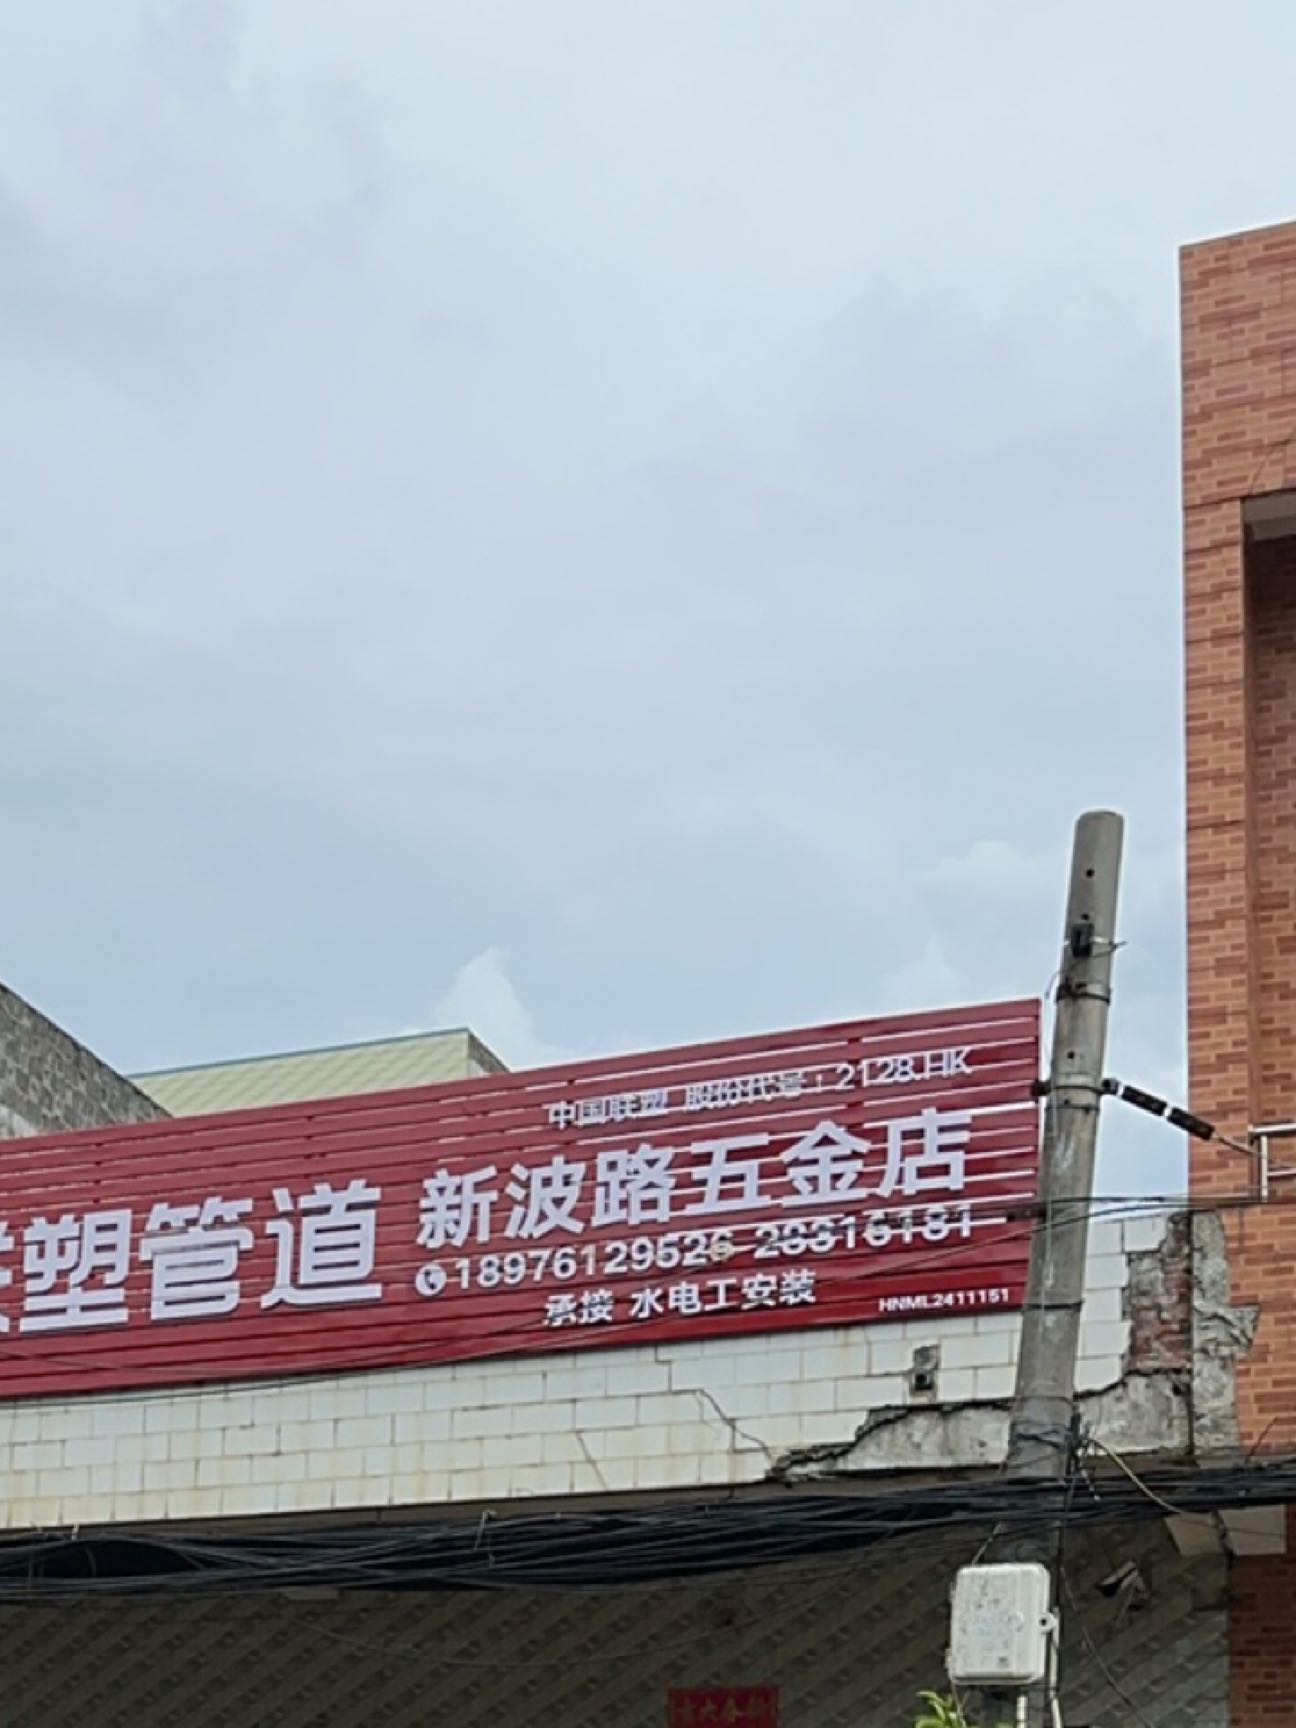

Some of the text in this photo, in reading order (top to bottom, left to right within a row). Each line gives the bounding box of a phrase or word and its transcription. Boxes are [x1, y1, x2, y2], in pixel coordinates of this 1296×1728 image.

[416, 1107, 973, 1250] 新波路五金店
[456, 1229, 736, 1290] 18976129526
[542, 1268, 817, 1328] 承接 水电工安装
